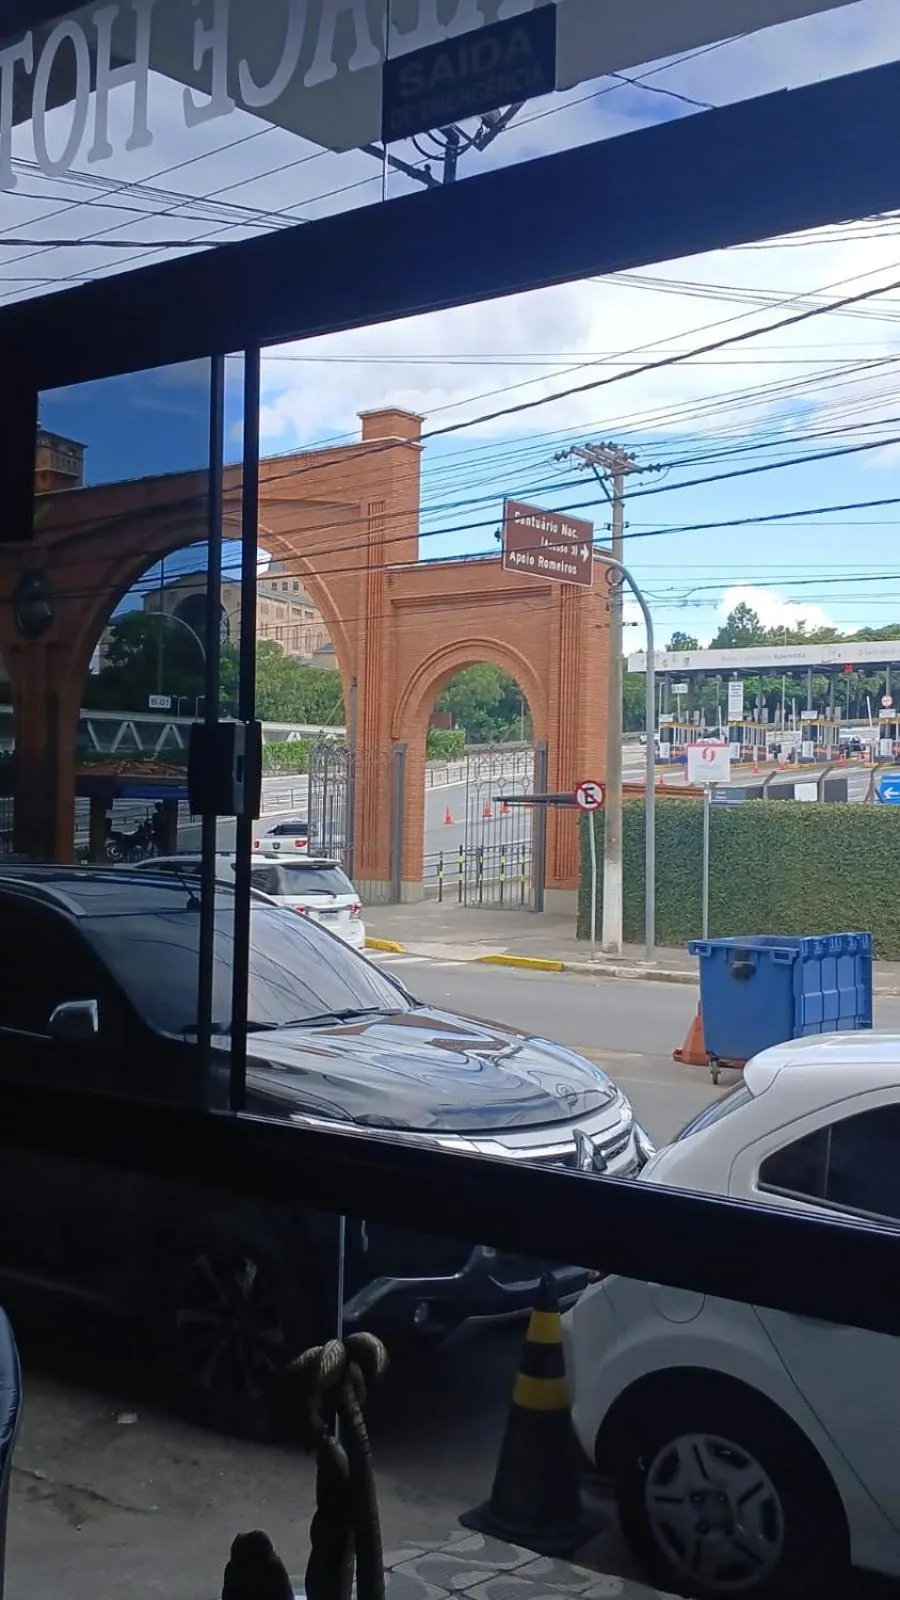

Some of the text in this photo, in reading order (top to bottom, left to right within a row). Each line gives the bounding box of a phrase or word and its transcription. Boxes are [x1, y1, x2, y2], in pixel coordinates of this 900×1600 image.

[514, 511, 579, 539] Santuário Nac.
[509, 551, 577, 575] Apoio Romeiros
